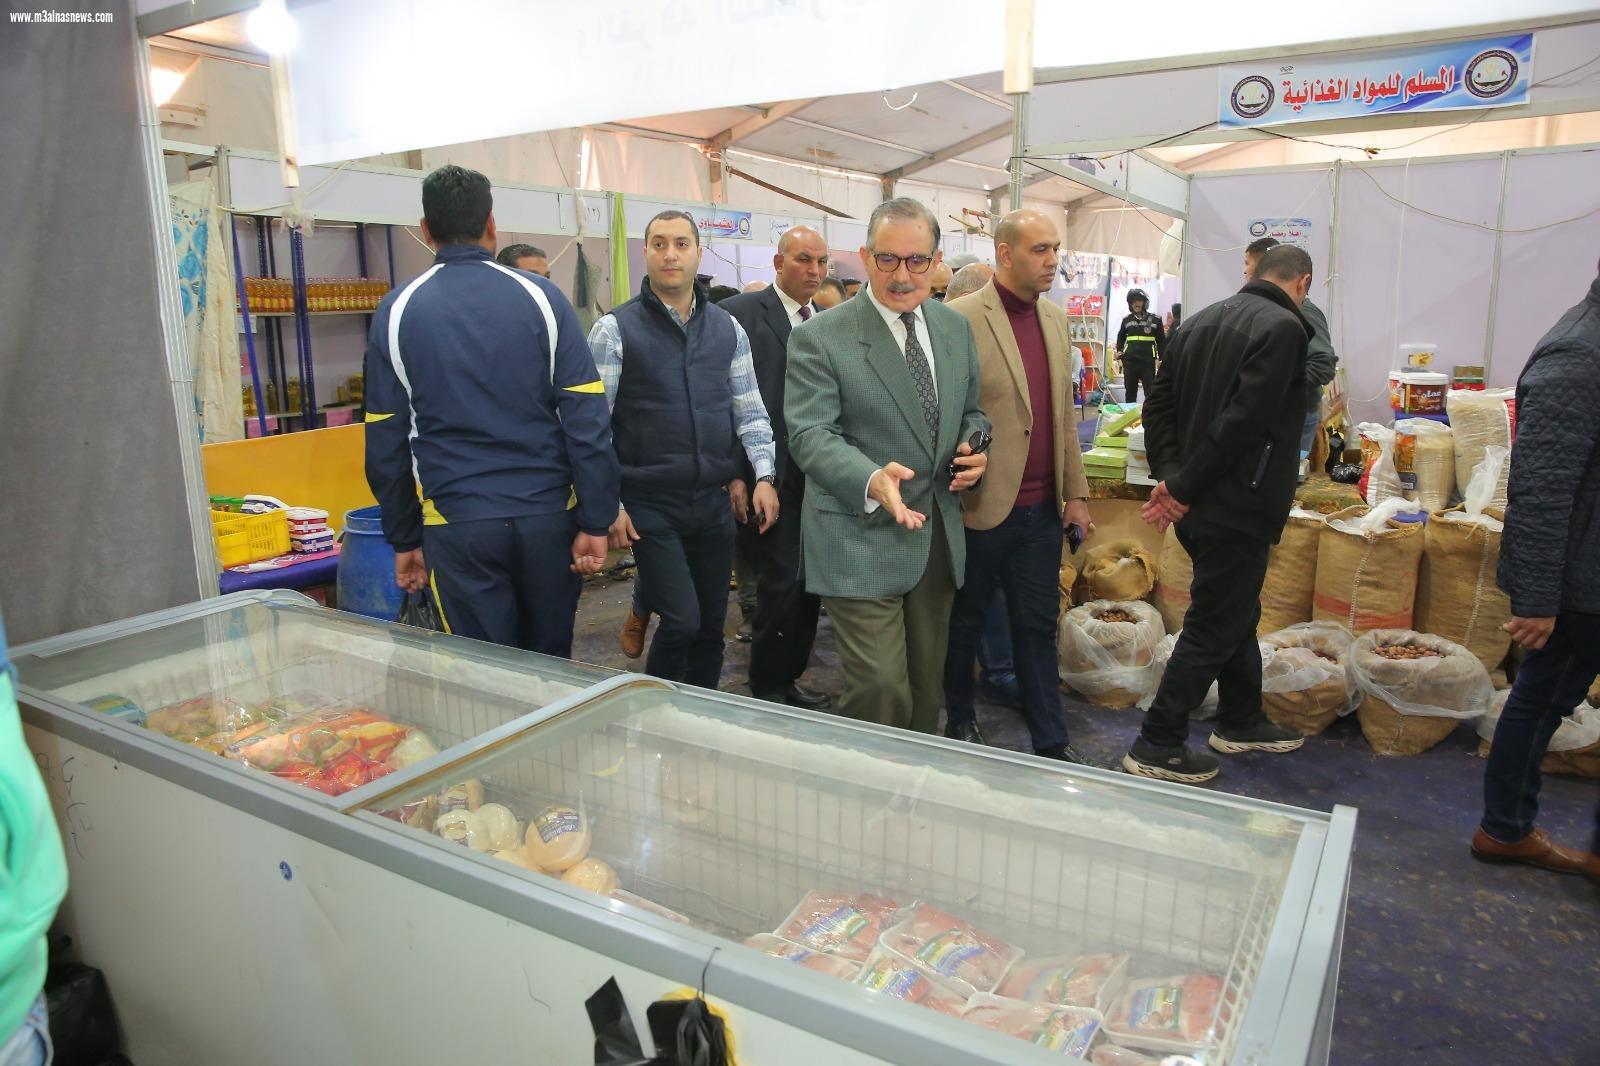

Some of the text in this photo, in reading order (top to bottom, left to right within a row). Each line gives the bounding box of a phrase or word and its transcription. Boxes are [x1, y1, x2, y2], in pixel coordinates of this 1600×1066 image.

[1282, 77, 1349, 111] الغذائية
[1353, 72, 1401, 104] للمواد
[1403, 65, 1454, 103] المسلم
